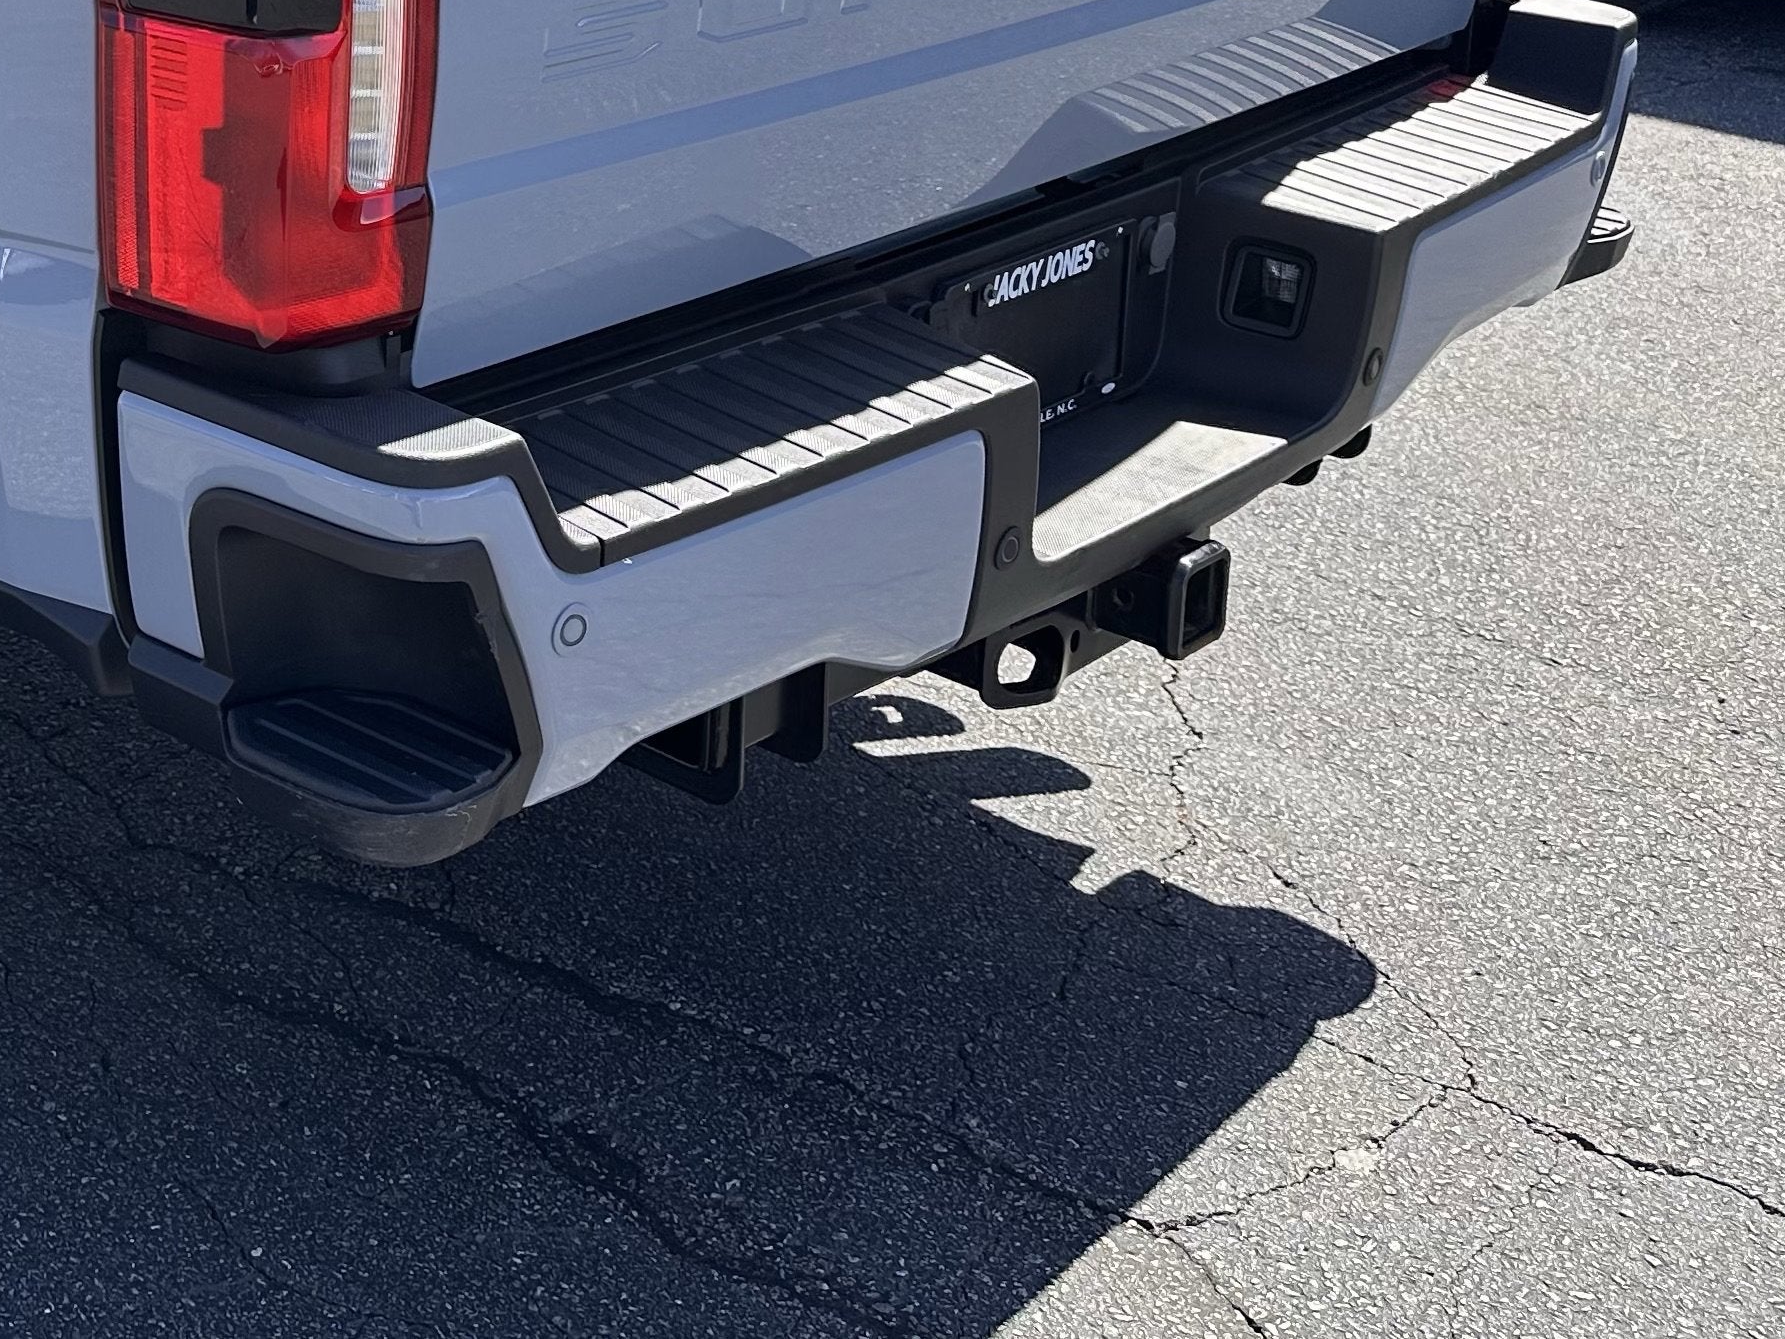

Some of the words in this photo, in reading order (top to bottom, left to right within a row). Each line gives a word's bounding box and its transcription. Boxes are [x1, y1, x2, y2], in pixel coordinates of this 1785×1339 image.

[987, 259, 1044, 307] JACKY
[1041, 239, 1097, 288] JONES
[1056, 398, 1078, 416] N.C.
